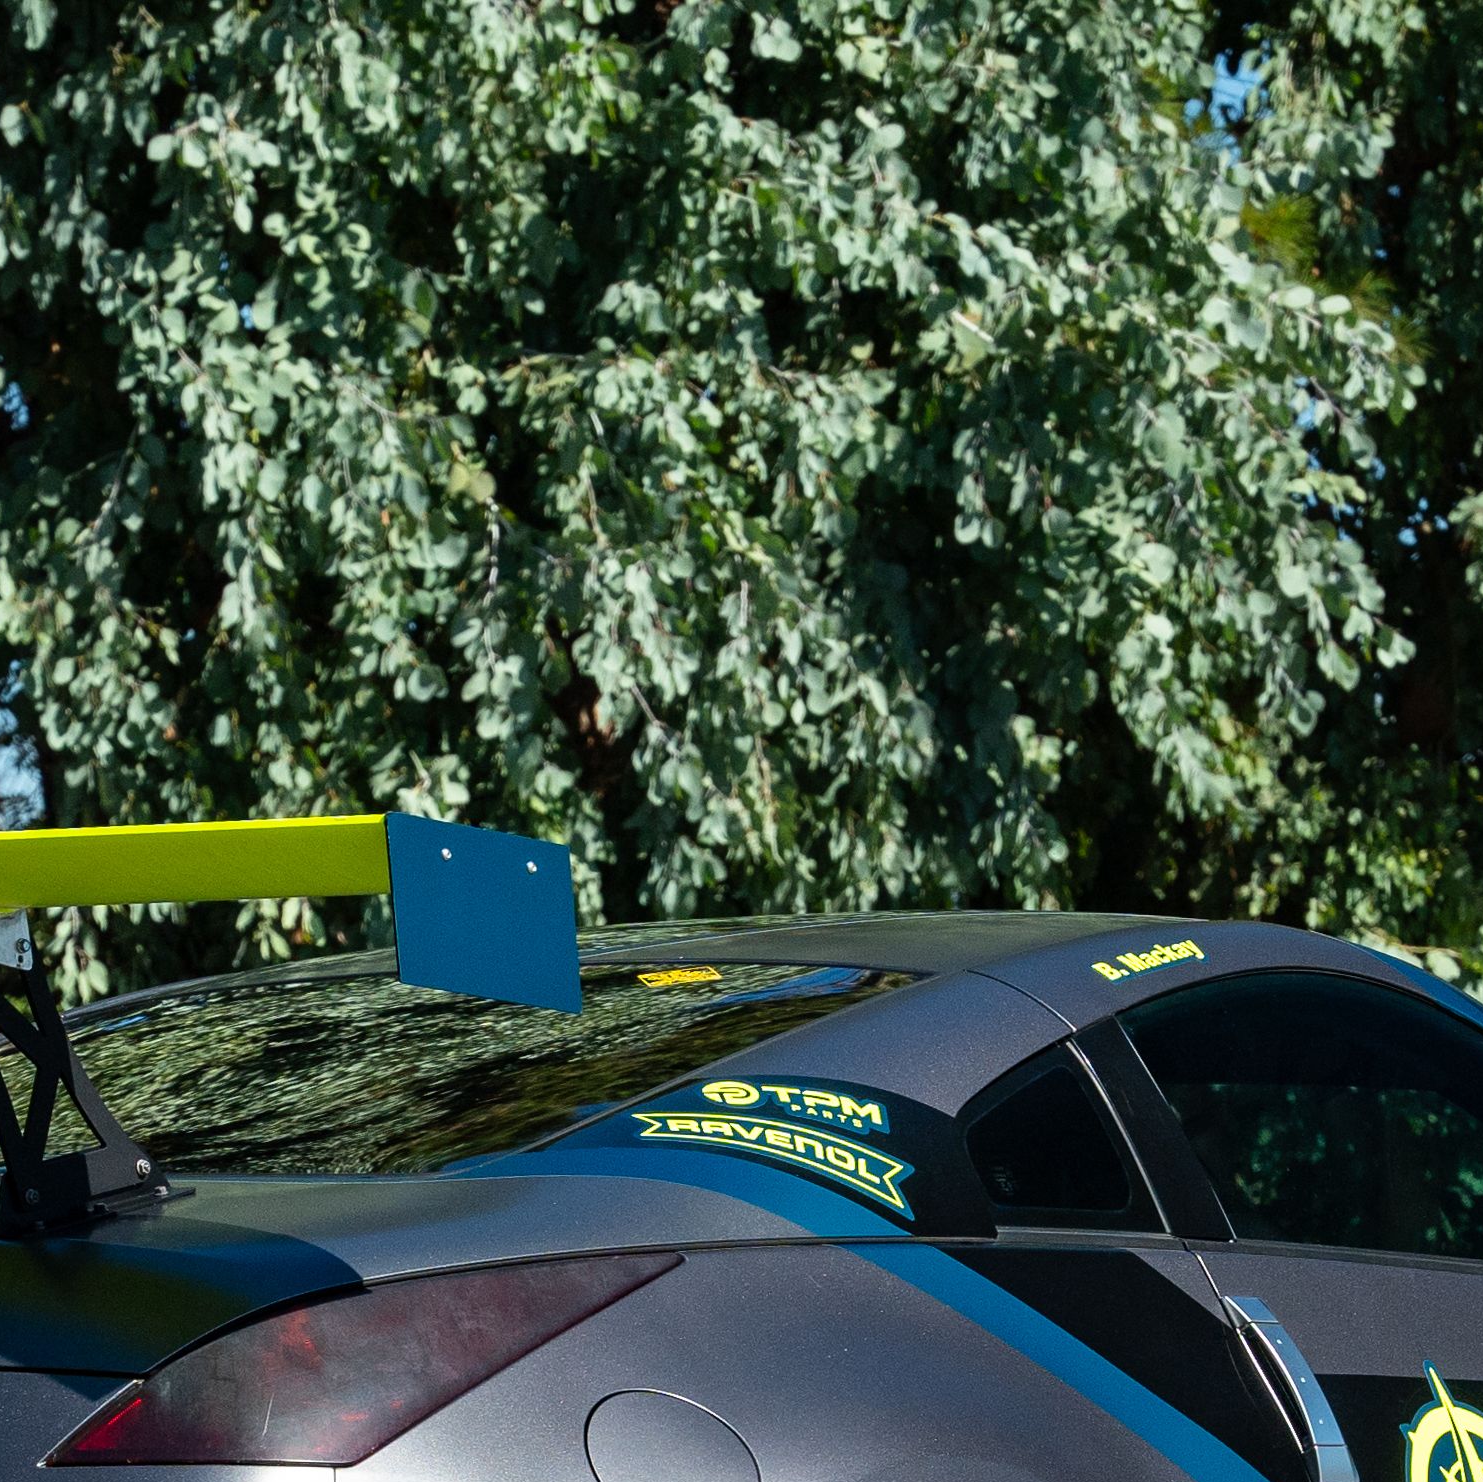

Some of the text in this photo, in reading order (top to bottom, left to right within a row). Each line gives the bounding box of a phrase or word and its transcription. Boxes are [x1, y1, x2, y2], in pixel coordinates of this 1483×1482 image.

[1091, 939, 1206, 981] B. Mackay
[761, 1085, 883, 1126] TPM
[790, 1103, 864, 1130] PARTS
[665, 1118, 881, 1184] RAVENOL
